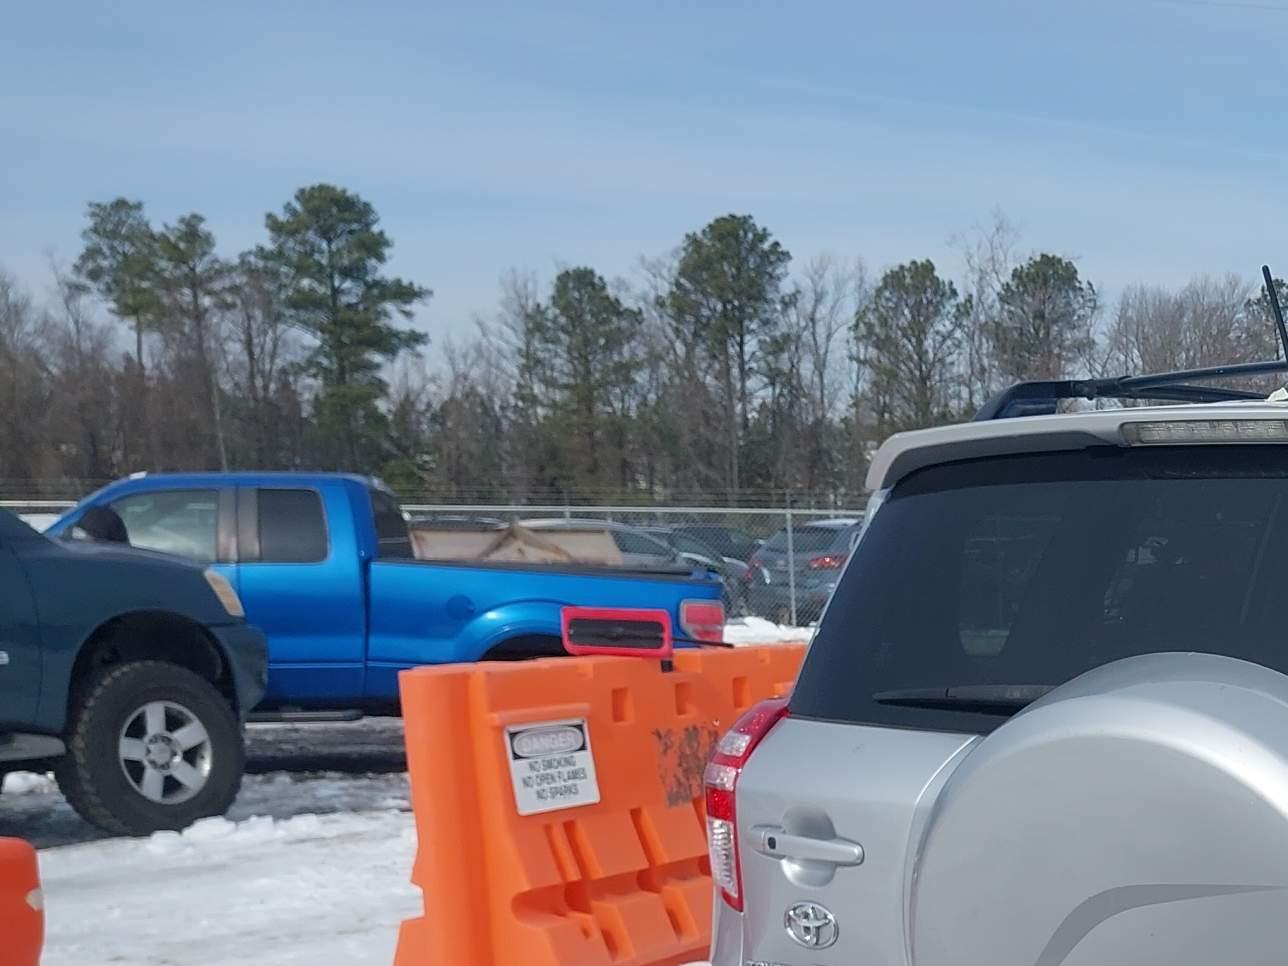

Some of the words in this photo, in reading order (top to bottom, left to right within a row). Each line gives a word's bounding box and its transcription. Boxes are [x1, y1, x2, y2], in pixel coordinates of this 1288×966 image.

[529, 760, 541, 772] NO
[542, 755, 577, 771] SMOKING
[522, 776, 534, 788] NO
[535, 773, 556, 787] OPEN
[557, 768, 587, 782] FLAMES
[536, 788, 548, 800] NO
